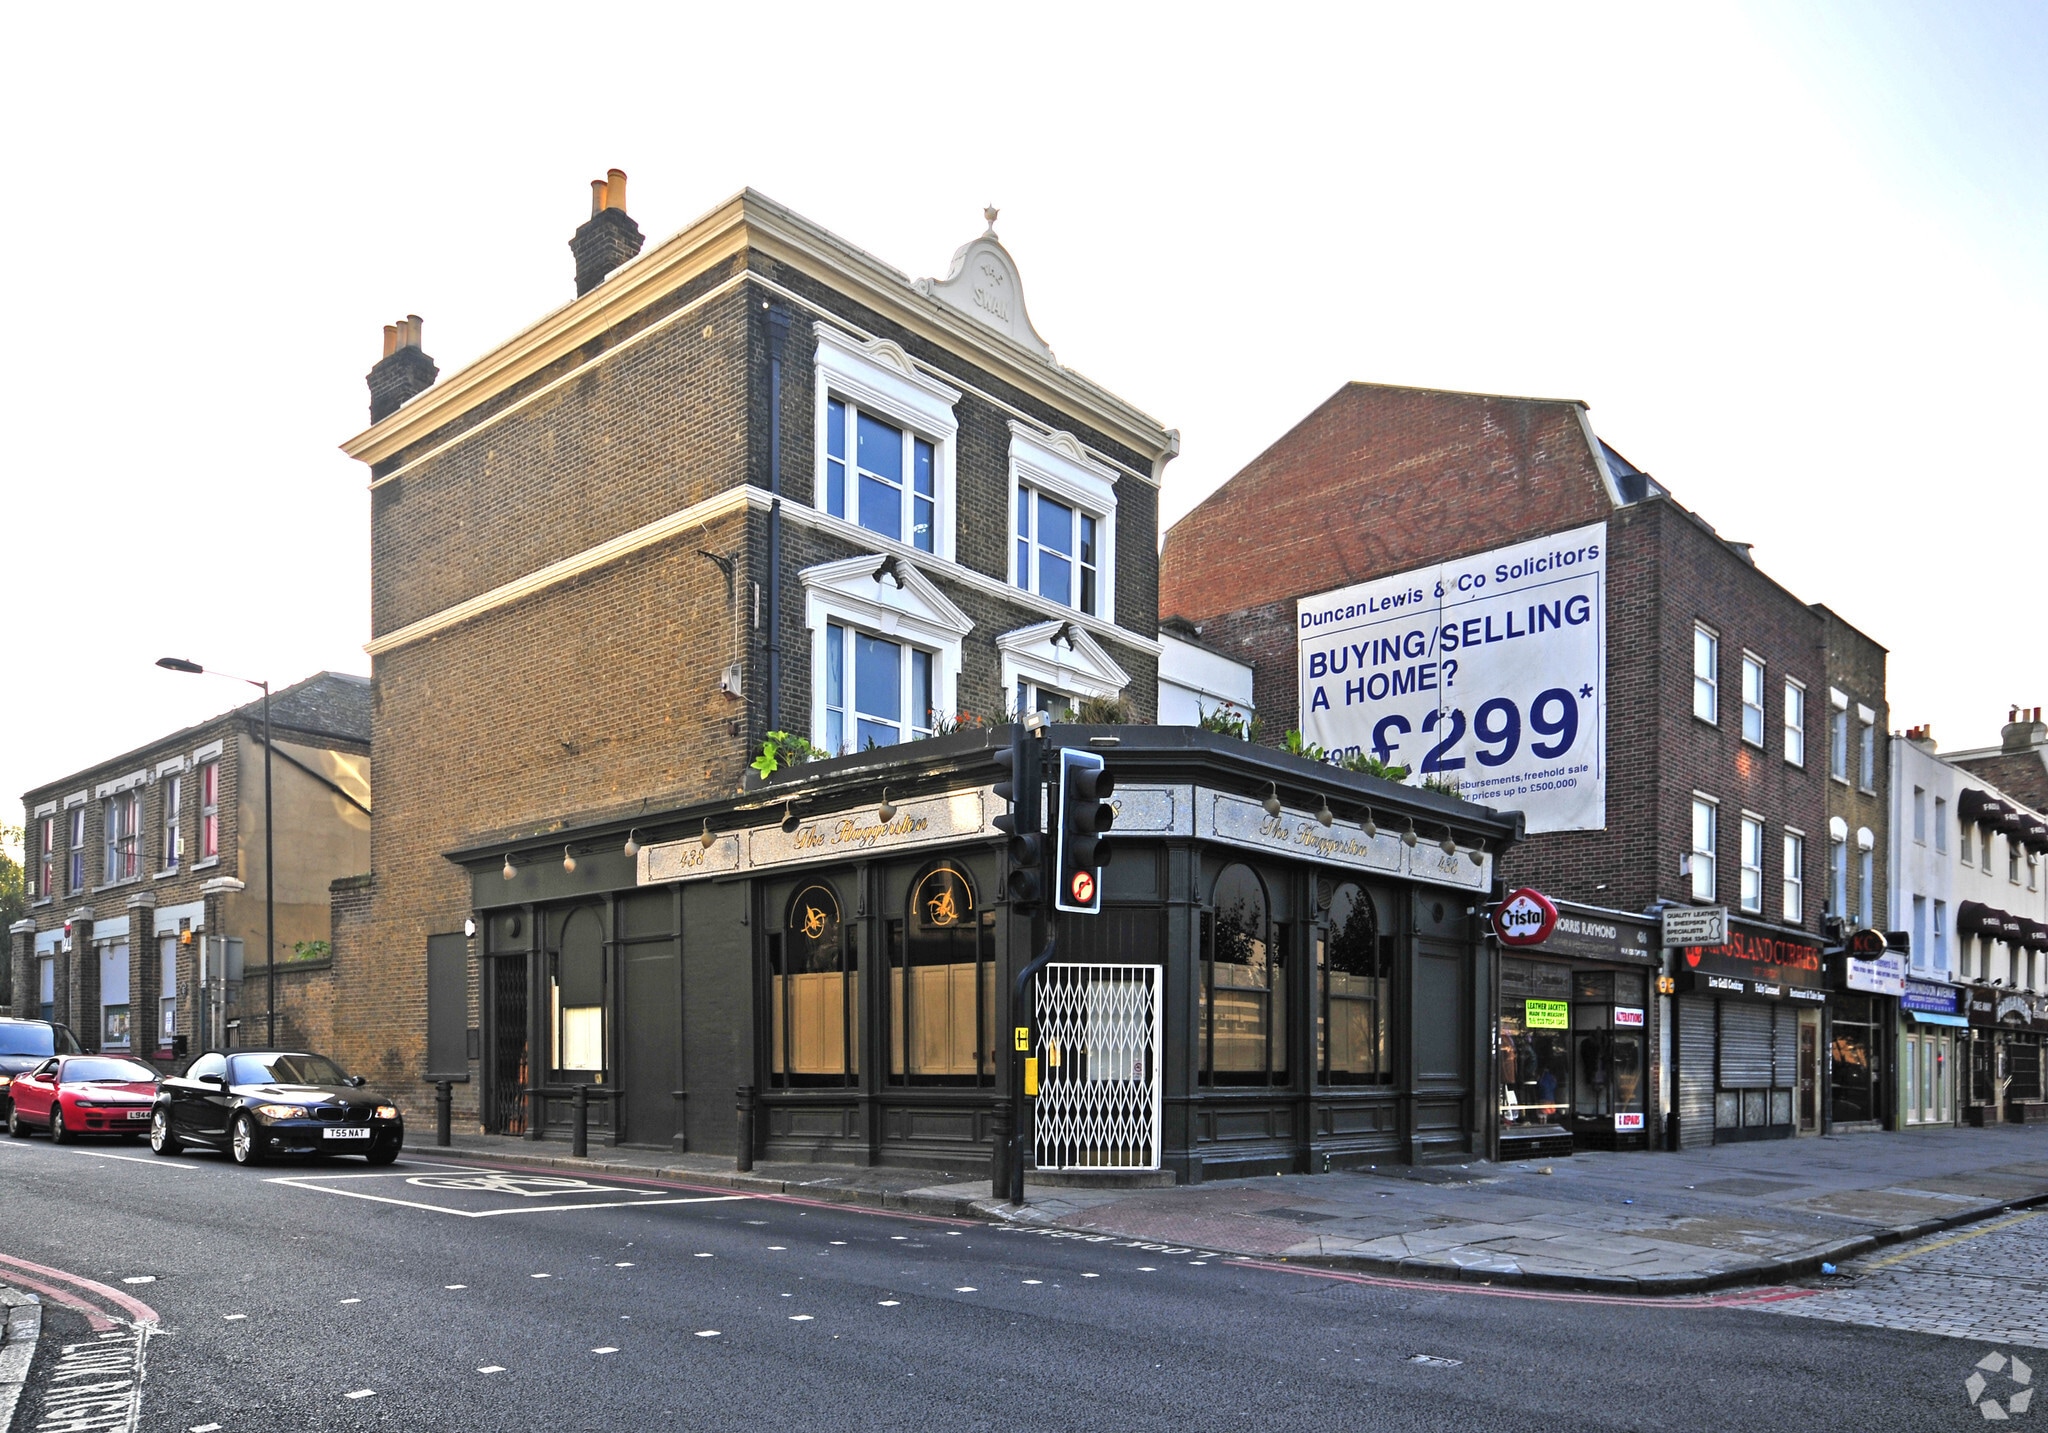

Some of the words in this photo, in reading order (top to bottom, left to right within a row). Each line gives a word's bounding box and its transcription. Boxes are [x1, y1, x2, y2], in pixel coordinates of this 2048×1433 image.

[973, 288, 1009, 323] SWAN
[1301, 602, 1366, 629] Duncan
[1369, 587, 1424, 613] Lewis
[1433, 580, 1446, 598] &
[1457, 572, 1486, 593] Co
[1495, 544, 1600, 583] Solicitors
[1309, 594, 1591, 680] BUYING/SELLING
[1311, 685, 1330, 713] A
[1345, 659, 1459, 706] HOME?
[1323, 745, 1361, 763] rom
[1524, 767, 1565, 781] freehold
[1568, 764, 1589, 774] sale
[1472, 788, 1501, 801] prices
[1504, 787, 1515, 798] up
[1518, 785, 1527, 794] to
[1530, 778, 1577, 793] £500,000)
[793, 825, 825, 849] The
[831, 813, 928, 847] Haggerston
[1259, 814, 1289, 841] The
[1294, 822, 1367, 858] Haggerston
[680, 848, 705, 868] 438
[1437, 856, 1459, 875] 438
[1500, 908, 1546, 930] Cristal
[1581, 921, 1617, 939] RAYMOND
[1527, 1002, 1547, 1010] LEATHER
[1548, 1003, 1567, 1011] JACKETS
[1616, 1012, 1643, 1023] ALTERATIONS
[129, 1111, 151, 1119] L944
[348, 1129, 365, 1137] NAT
